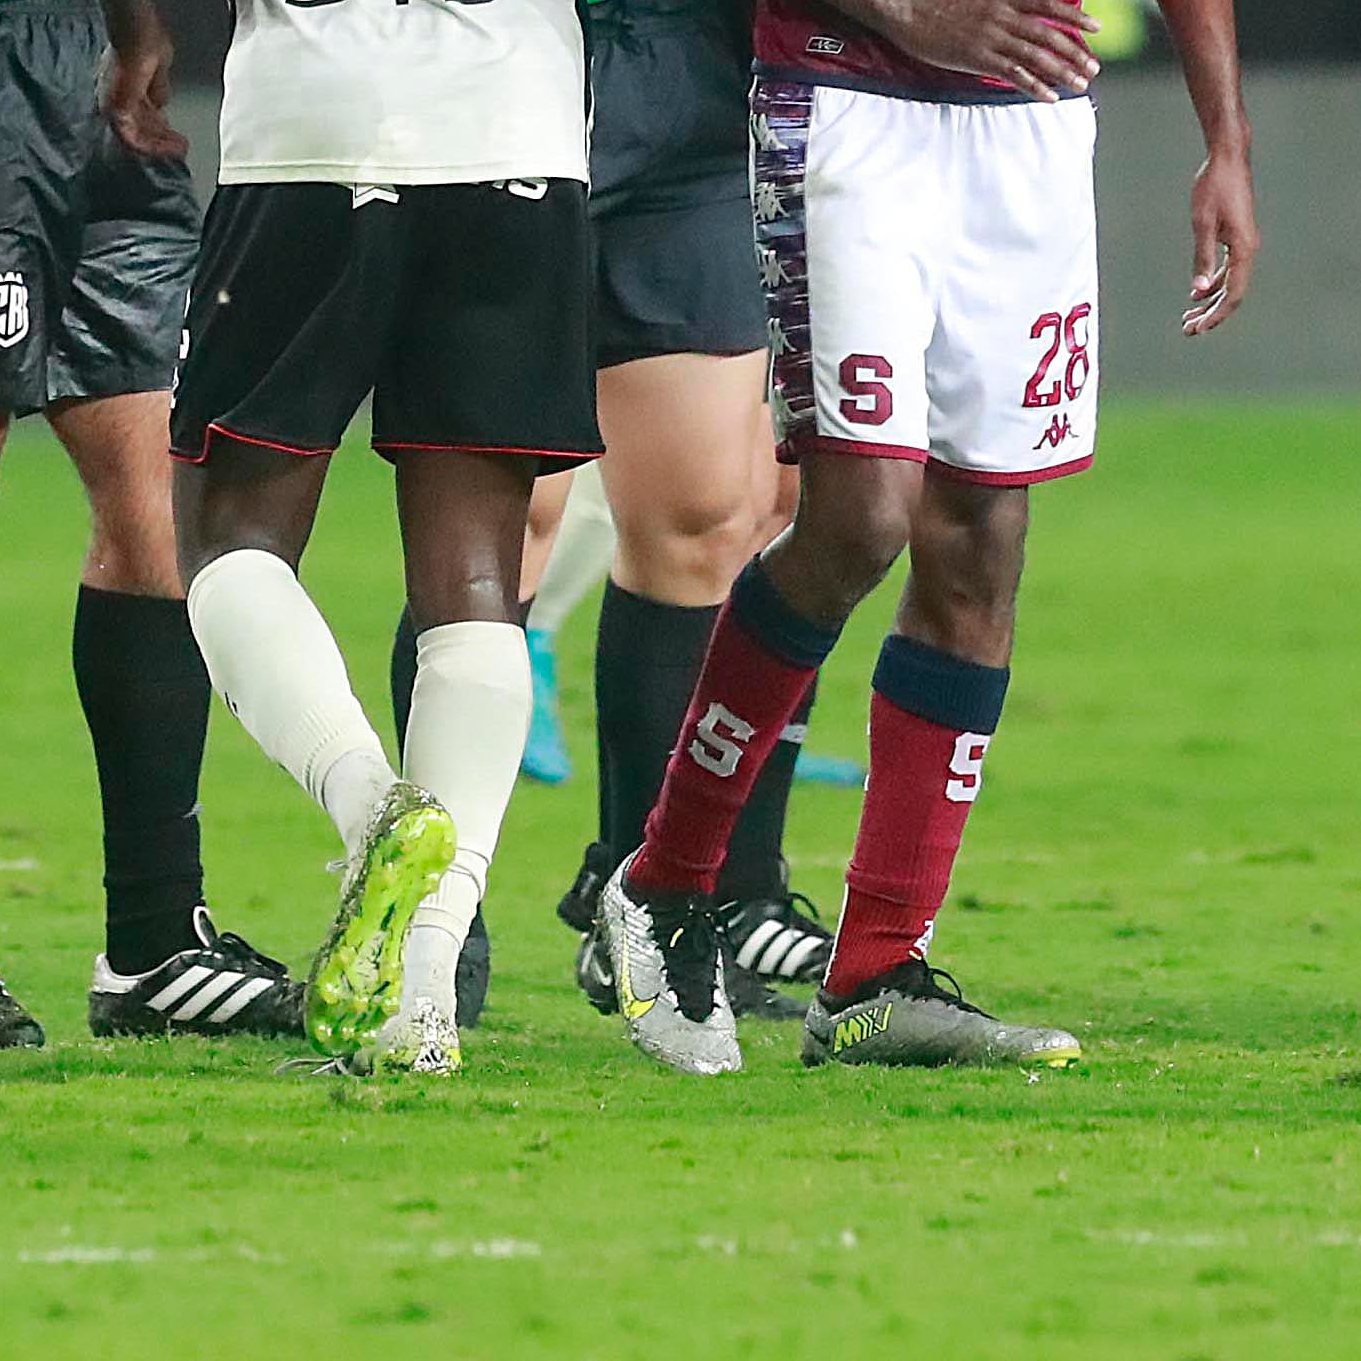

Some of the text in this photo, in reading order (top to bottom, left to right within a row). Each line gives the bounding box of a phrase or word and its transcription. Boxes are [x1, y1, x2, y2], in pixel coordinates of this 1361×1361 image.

[839, 353, 894, 426] S
[1021, 301, 1092, 409] 28
[688, 701, 757, 778] S
